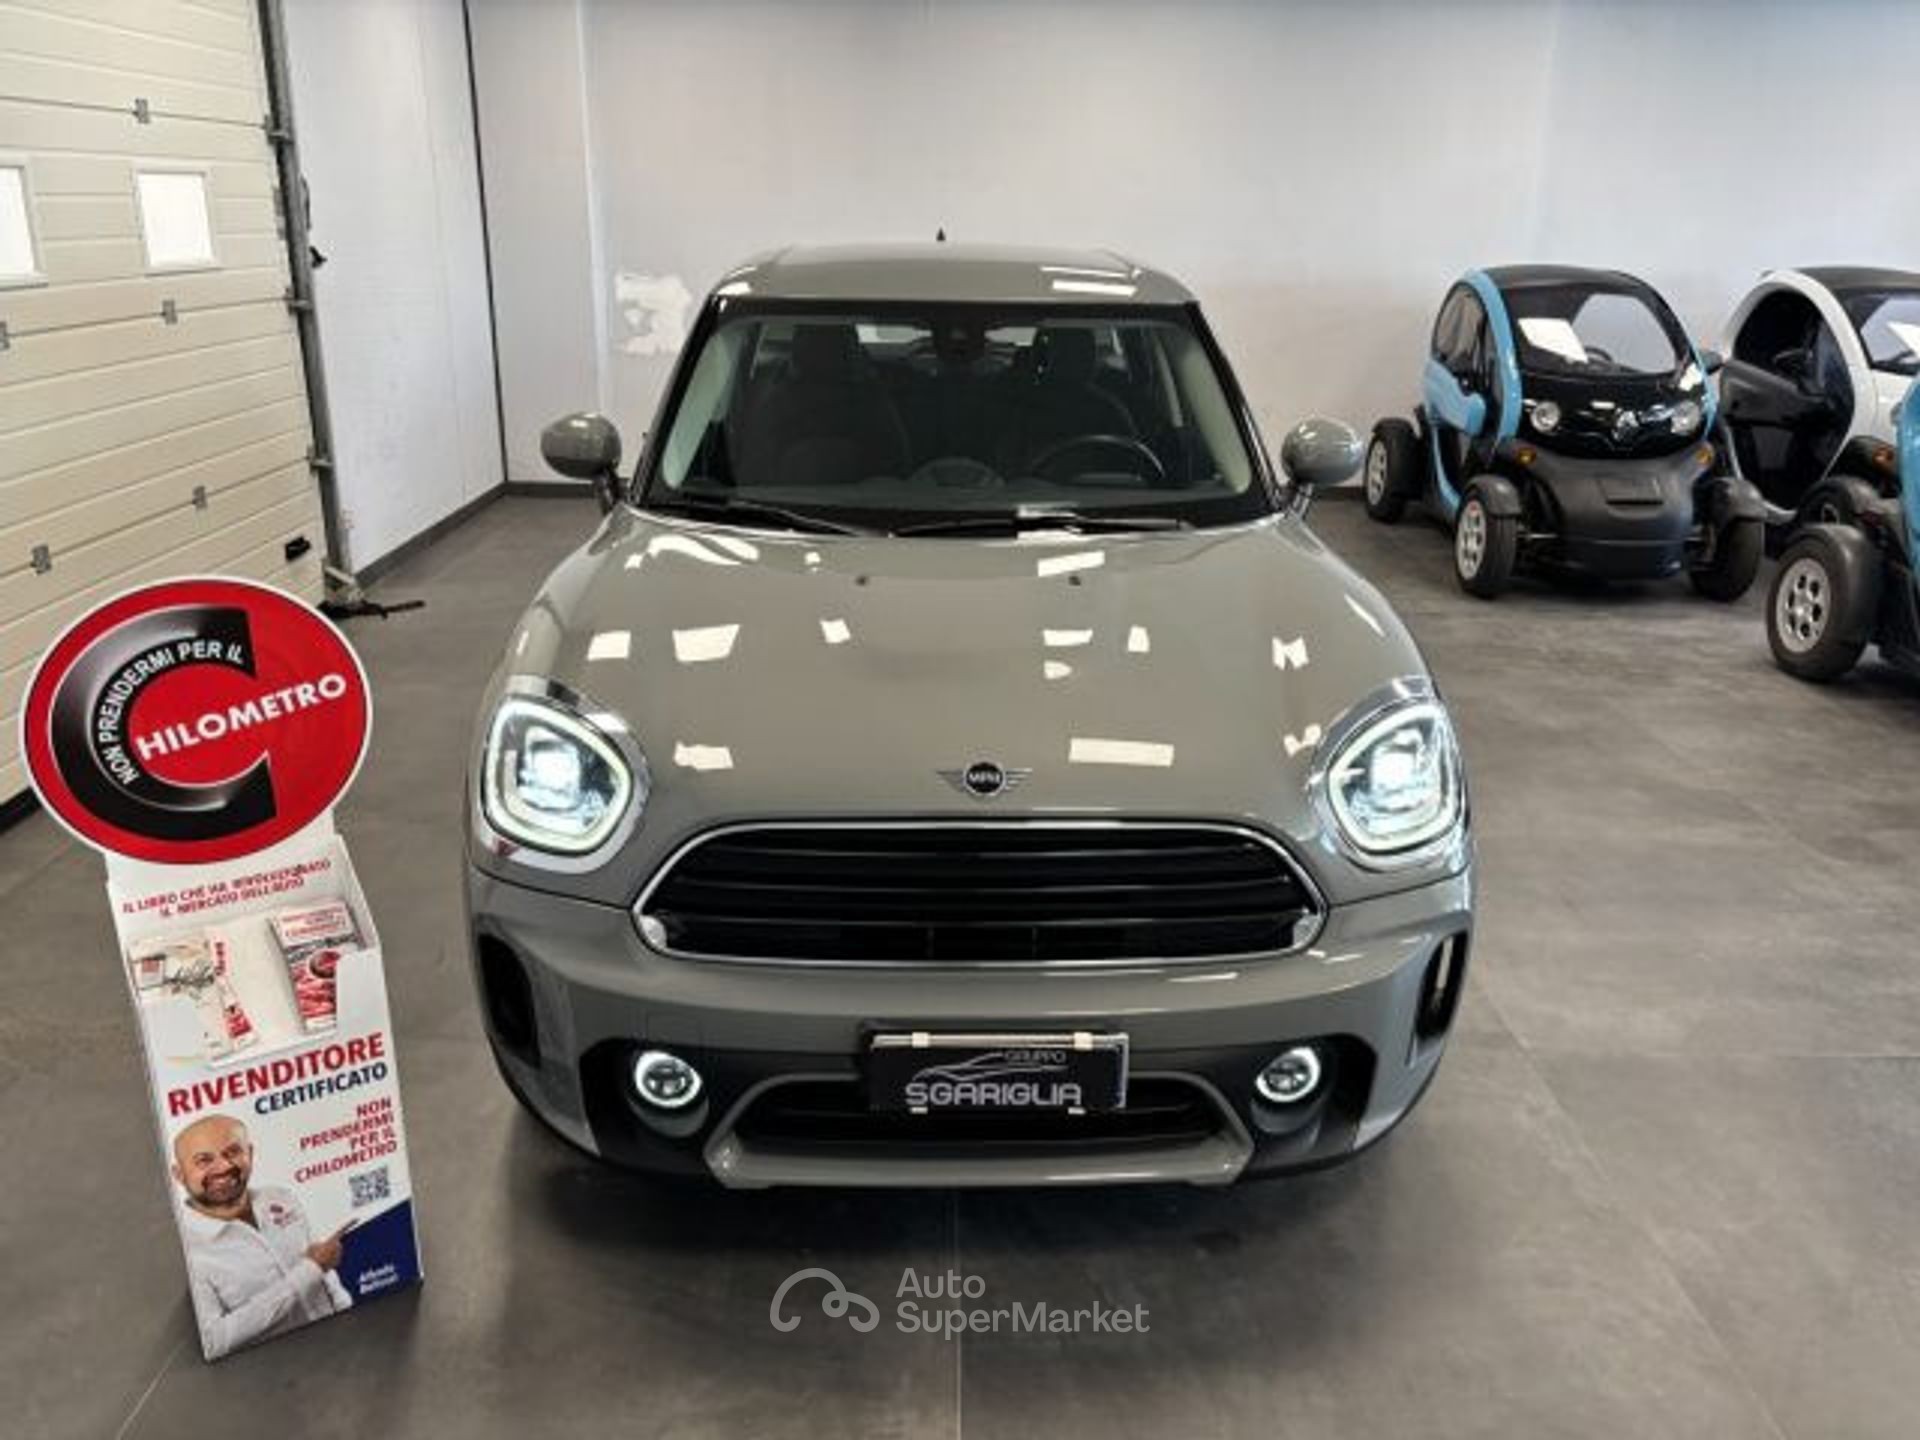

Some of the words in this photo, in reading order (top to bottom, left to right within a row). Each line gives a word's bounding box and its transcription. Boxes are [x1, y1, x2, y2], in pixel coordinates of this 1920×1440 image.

[178, 639, 223, 661] PER
[228, 642, 245, 665] IL
[97, 648, 176, 743] PRENDERMI
[101, 744, 140, 786] NON
[168, 1032, 385, 1117] RIVENDITORE
[254, 1061, 388, 1115] CERTIFICATO
[905, 1082, 1082, 1106] SGARIGLIA
[357, 1096, 392, 1117] NON
[299, 1111, 394, 1150] PRENDERMI
[350, 1131, 379, 1150] PER
[294, 1140, 397, 1183] CHILOMETRO
